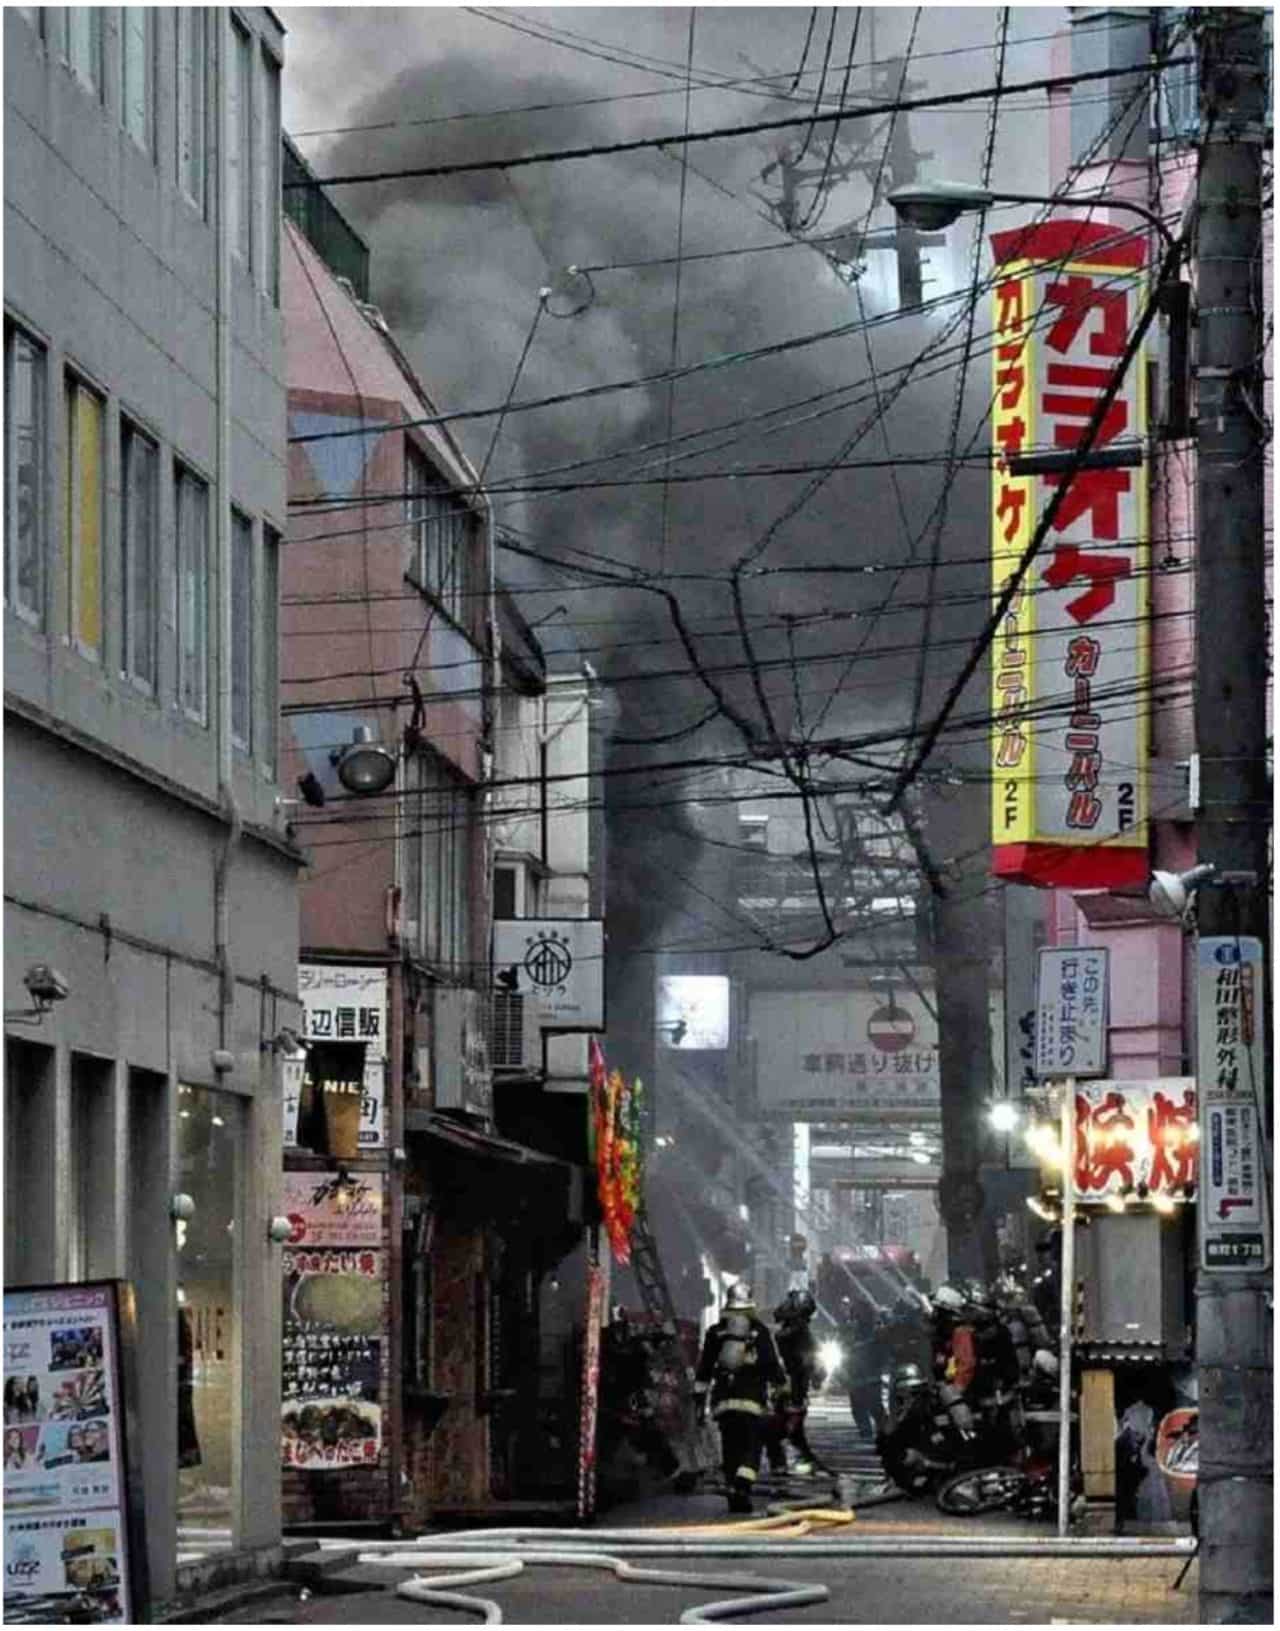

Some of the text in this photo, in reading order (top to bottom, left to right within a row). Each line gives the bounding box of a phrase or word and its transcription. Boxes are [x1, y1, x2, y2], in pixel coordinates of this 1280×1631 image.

[996, 278, 1026, 542] カラオケ
[1042, 276, 1132, 626] カラオケ
[1065, 636, 1101, 830] カーニバル
[303, 1006, 380, 1037] 辺信販
[1060, 958, 1079, 1067] 行き止まり
[1075, 1087, 1199, 1192] 浜焼
